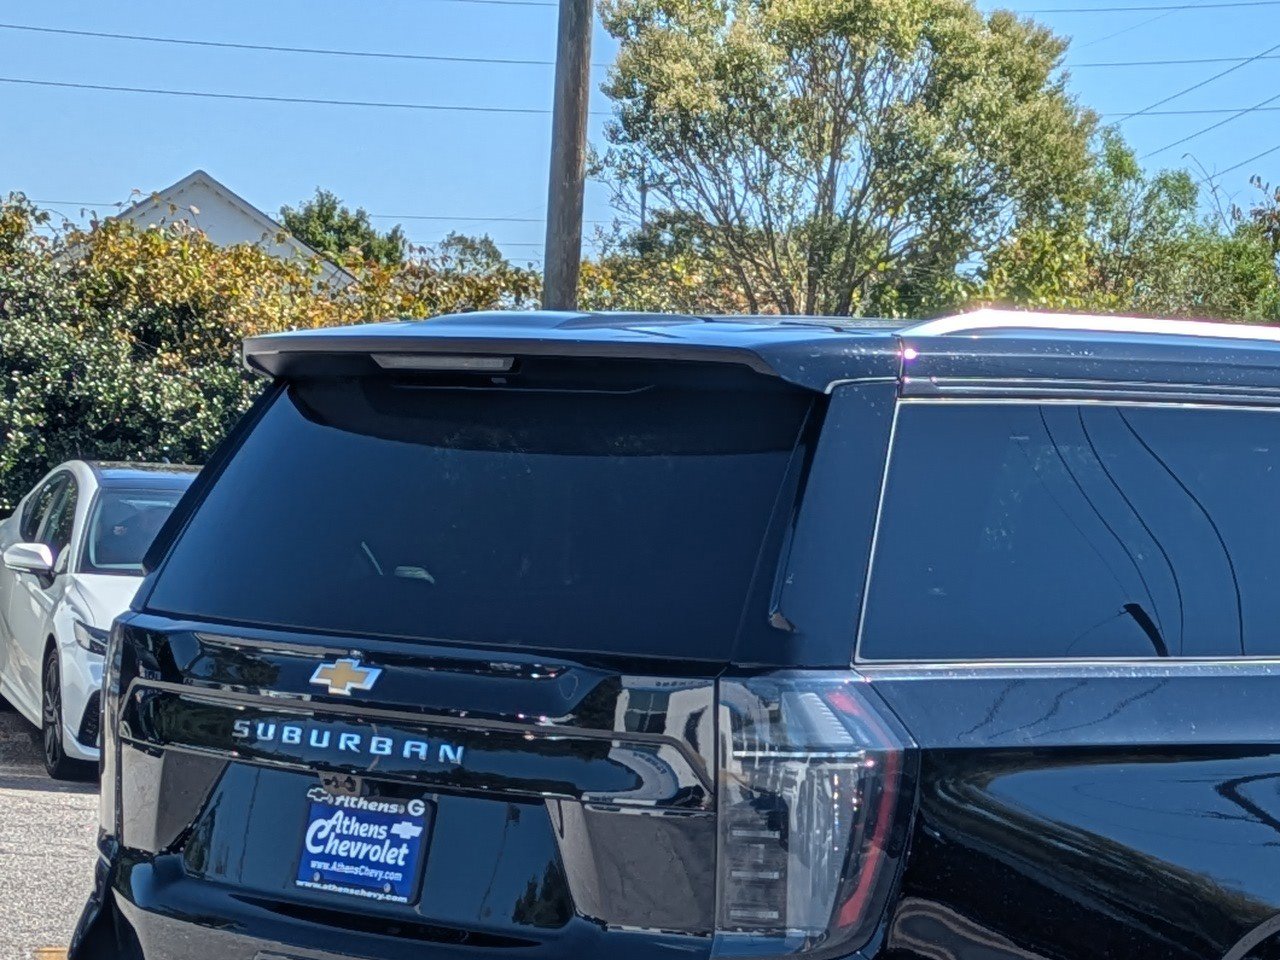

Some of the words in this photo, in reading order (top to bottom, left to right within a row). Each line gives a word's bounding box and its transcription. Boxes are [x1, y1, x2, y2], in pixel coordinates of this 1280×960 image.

[232, 719, 465, 765] SUBURBAN
[305, 818, 409, 867] Chevrolet
[318, 809, 389, 840] Athens
[310, 860, 403, 882] www.AthensChevy.com
